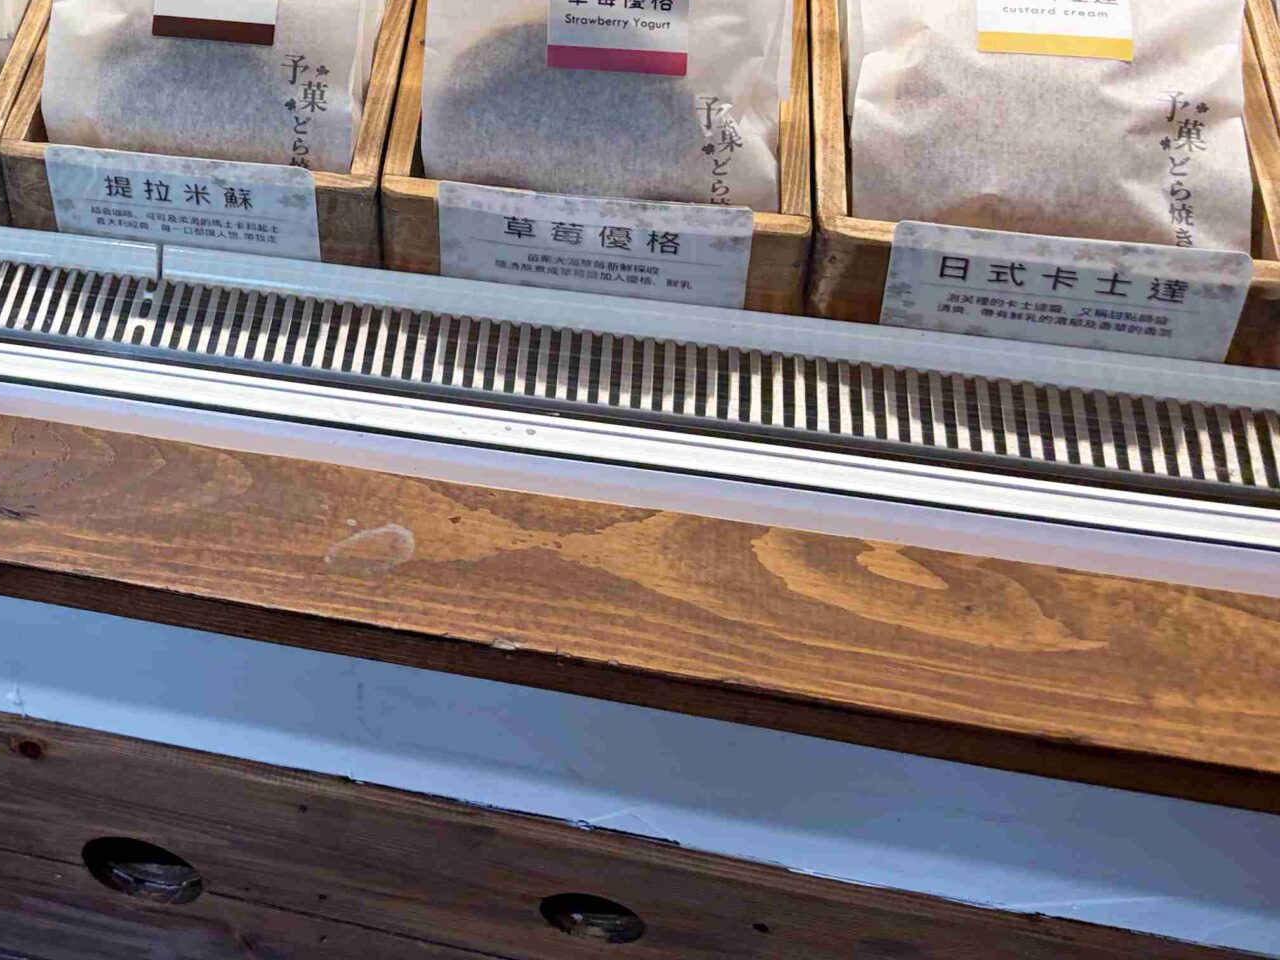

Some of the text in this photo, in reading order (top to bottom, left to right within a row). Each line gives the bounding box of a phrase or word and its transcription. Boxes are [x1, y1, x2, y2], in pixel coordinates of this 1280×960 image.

[565, 14, 671, 31] Strawberry Yogurt
[1002, 6, 1108, 18] custard cream
[104, 174, 254, 210] 提拉米蘇
[503, 216, 681, 256] 草莓優格
[938, 255, 1189, 305] 日式卡士達
